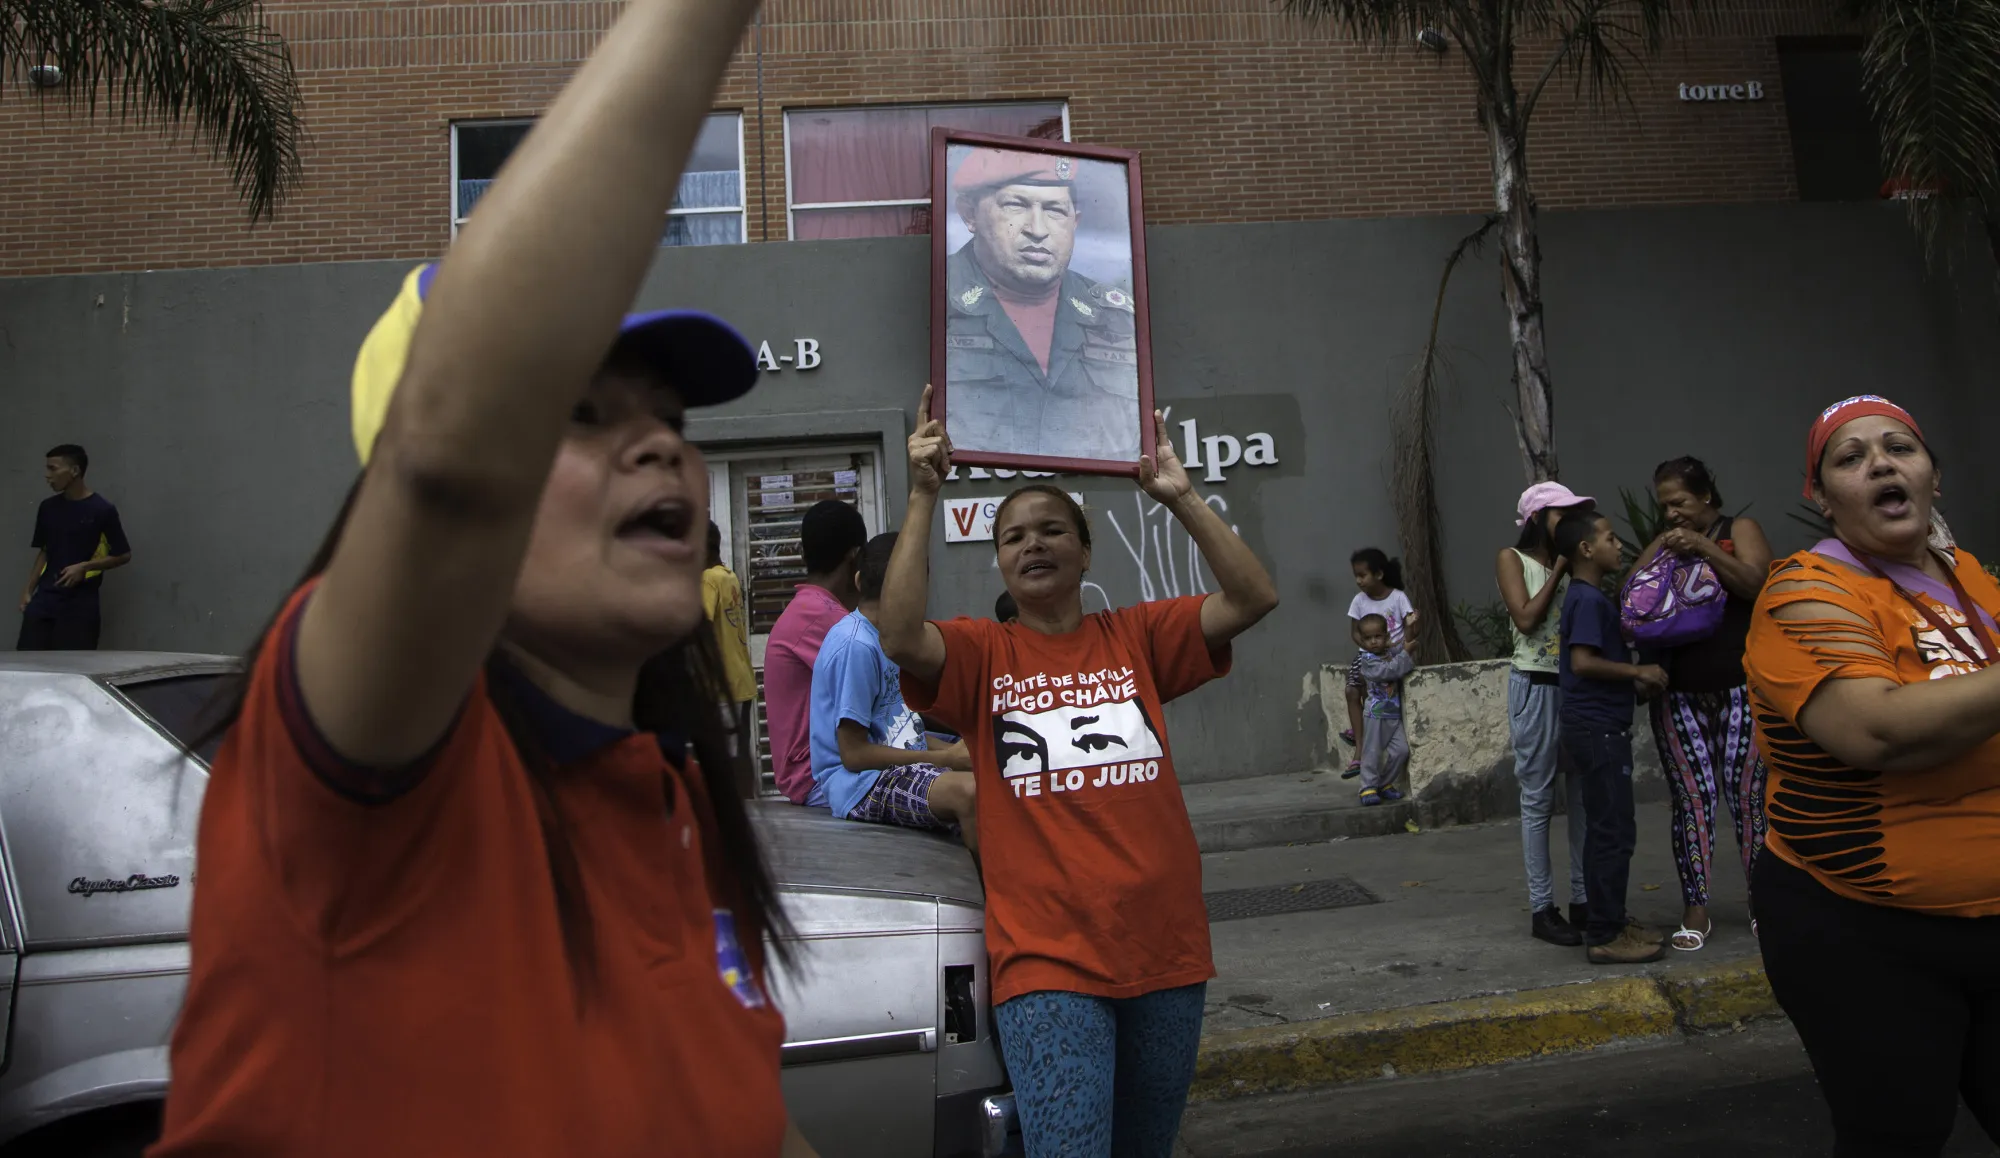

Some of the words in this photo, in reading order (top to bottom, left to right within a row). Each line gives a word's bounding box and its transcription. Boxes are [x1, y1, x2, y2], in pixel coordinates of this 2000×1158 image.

[1679, 82, 1745, 101] torre
[1745, 80, 1764, 99] B
[756, 338, 821, 371] A-B
[1168, 418, 1279, 482] lpa
[1050, 673, 1074, 688] DE
[1077, 665, 1134, 685] BATALL
[992, 690, 1054, 713] HUGO
[1060, 677, 1137, 706] CHÁVE
[1011, 775, 1042, 798] TE
[1050, 769, 1085, 793] LO
[1092, 760, 1159, 789] JURO
